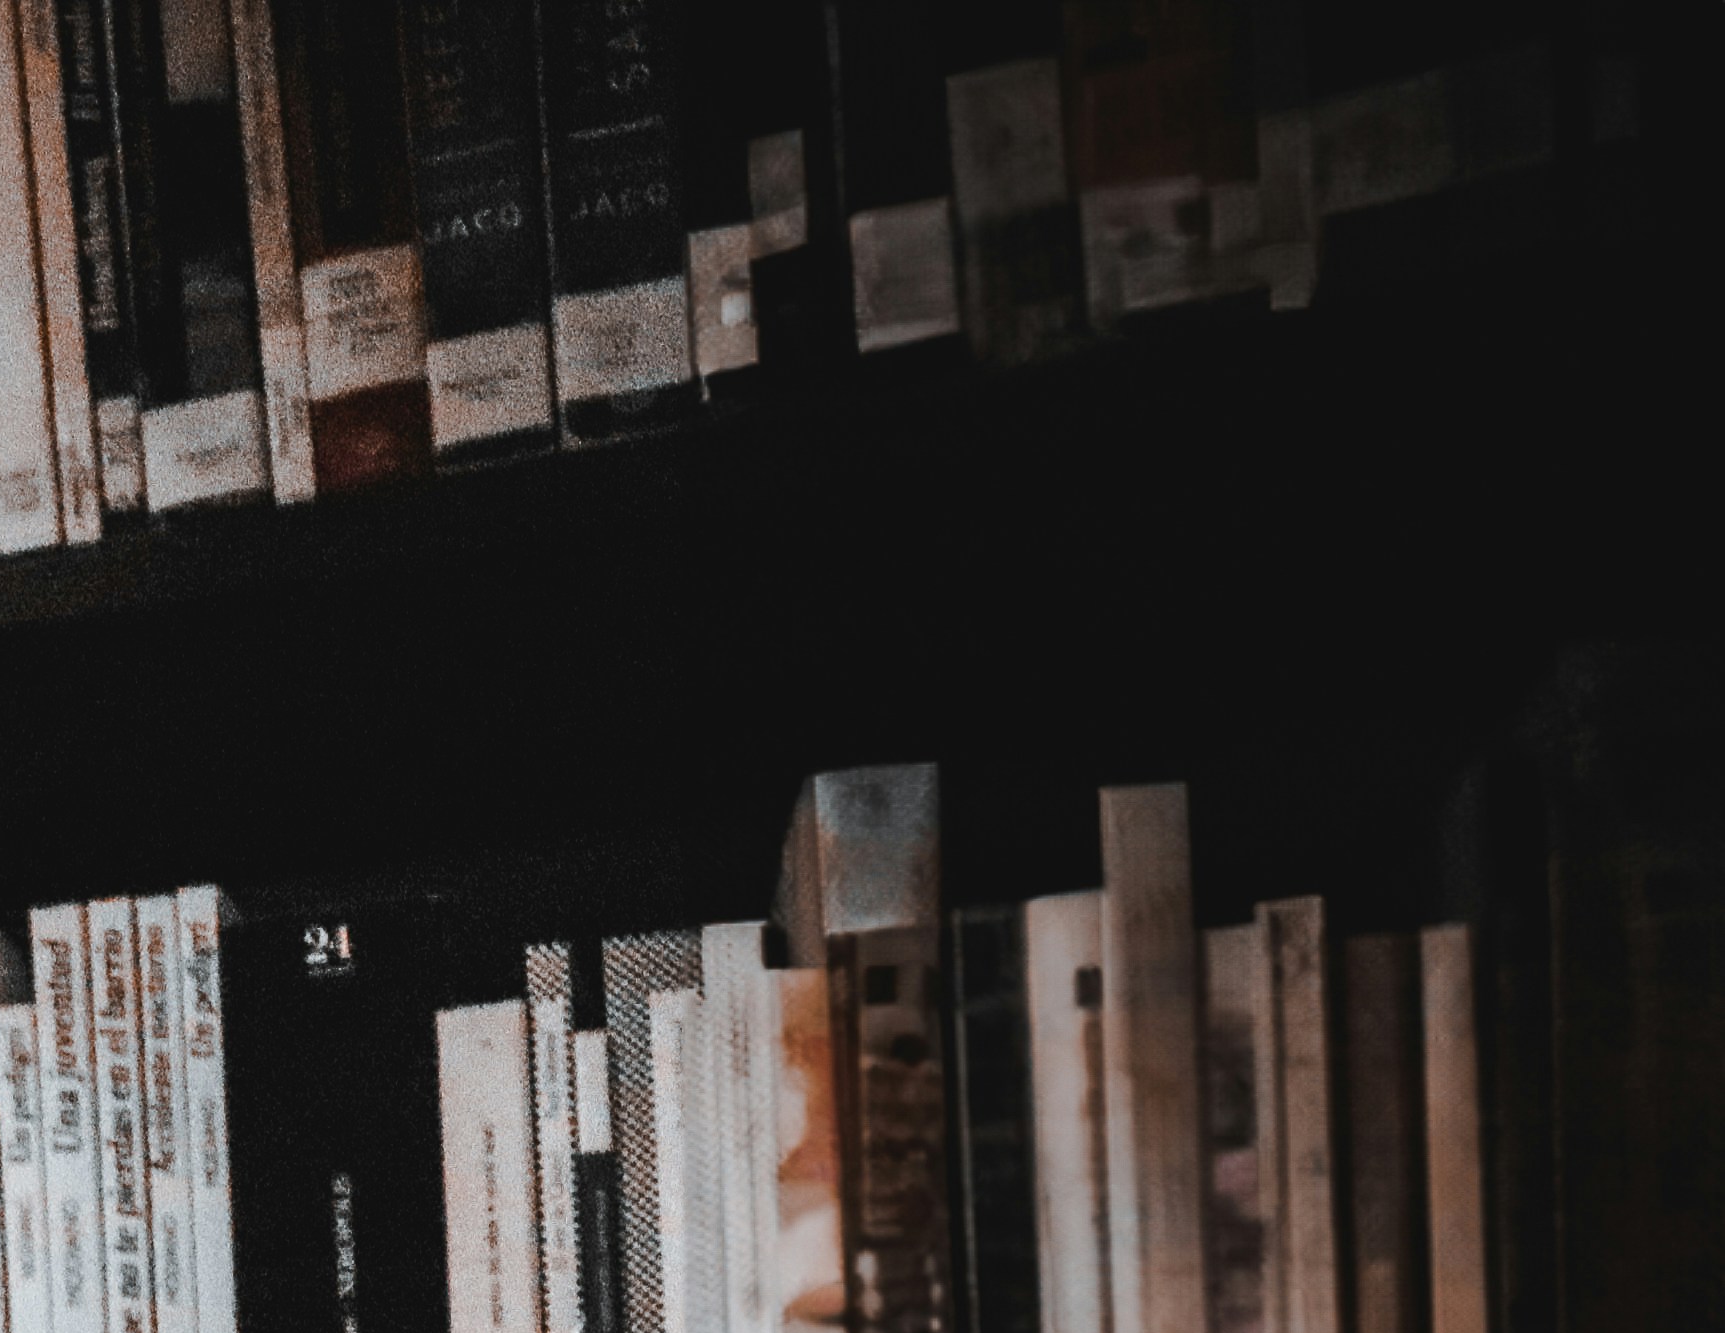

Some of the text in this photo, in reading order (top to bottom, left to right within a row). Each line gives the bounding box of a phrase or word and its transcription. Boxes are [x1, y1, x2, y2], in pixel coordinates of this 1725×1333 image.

[51, 1090, 80, 1154] Una
[105, 1108, 144, 1218] pierdas
[117, 1262, 139, 1298] no
